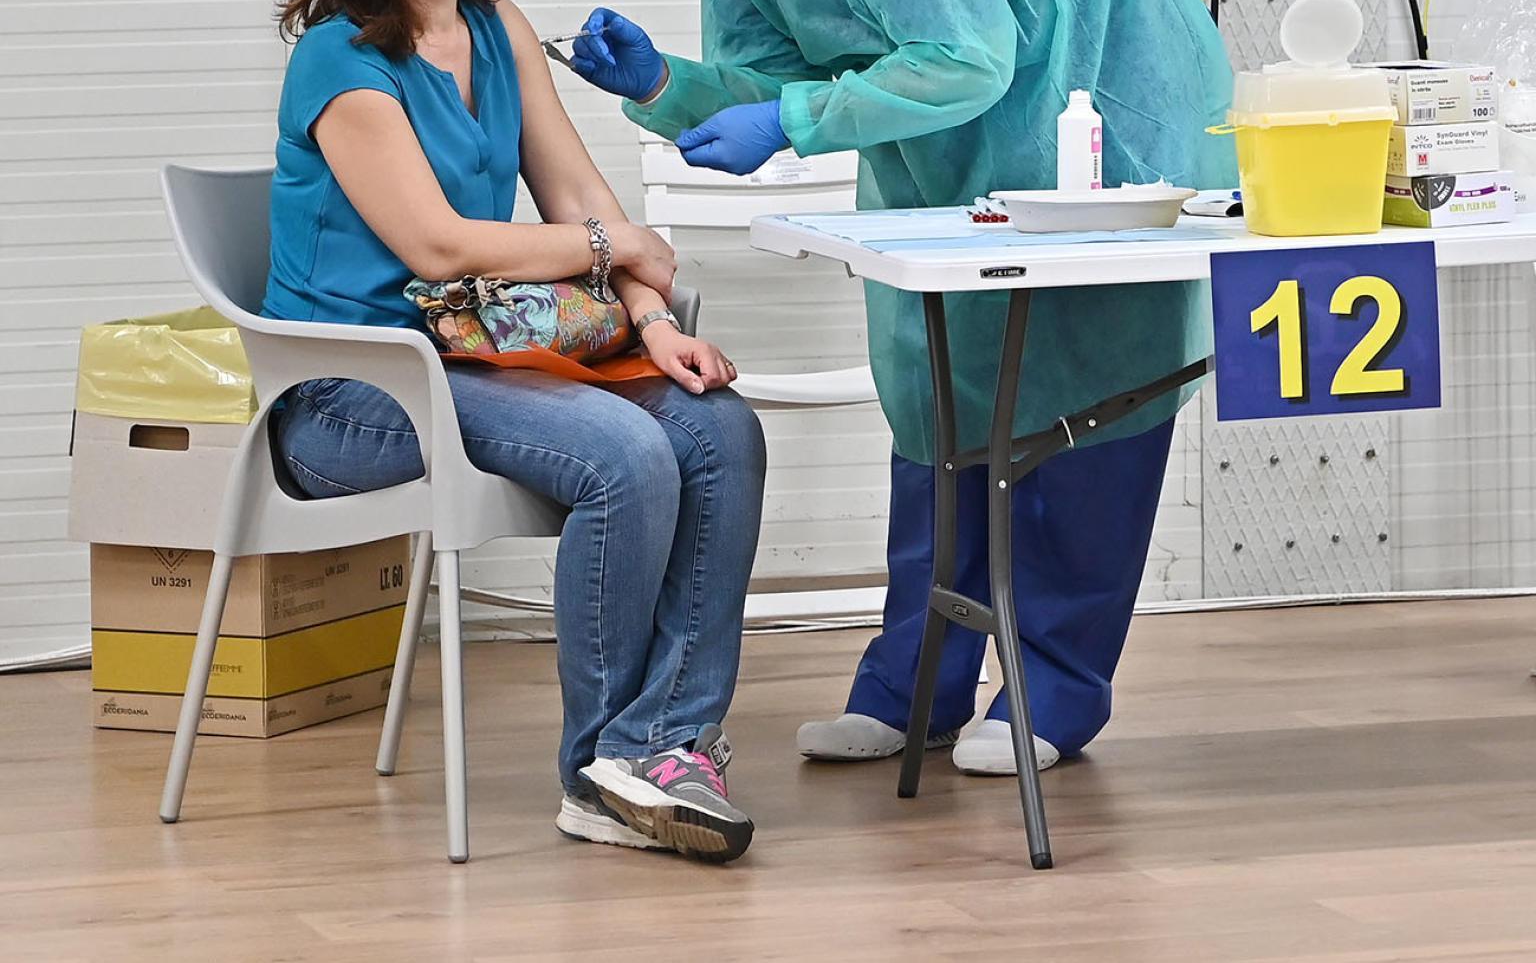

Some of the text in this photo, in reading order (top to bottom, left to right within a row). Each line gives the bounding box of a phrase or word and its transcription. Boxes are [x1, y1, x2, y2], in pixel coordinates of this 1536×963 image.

[1472, 107, 1488, 117] 100
[1471, 129, 1488, 137] Vinyl
[1418, 154, 1427, 164] M
[1250, 274, 1406, 400] 12
[392, 564, 404, 589] 60
[151, 577, 192, 588] UN 3291
[647, 757, 690, 788] N
